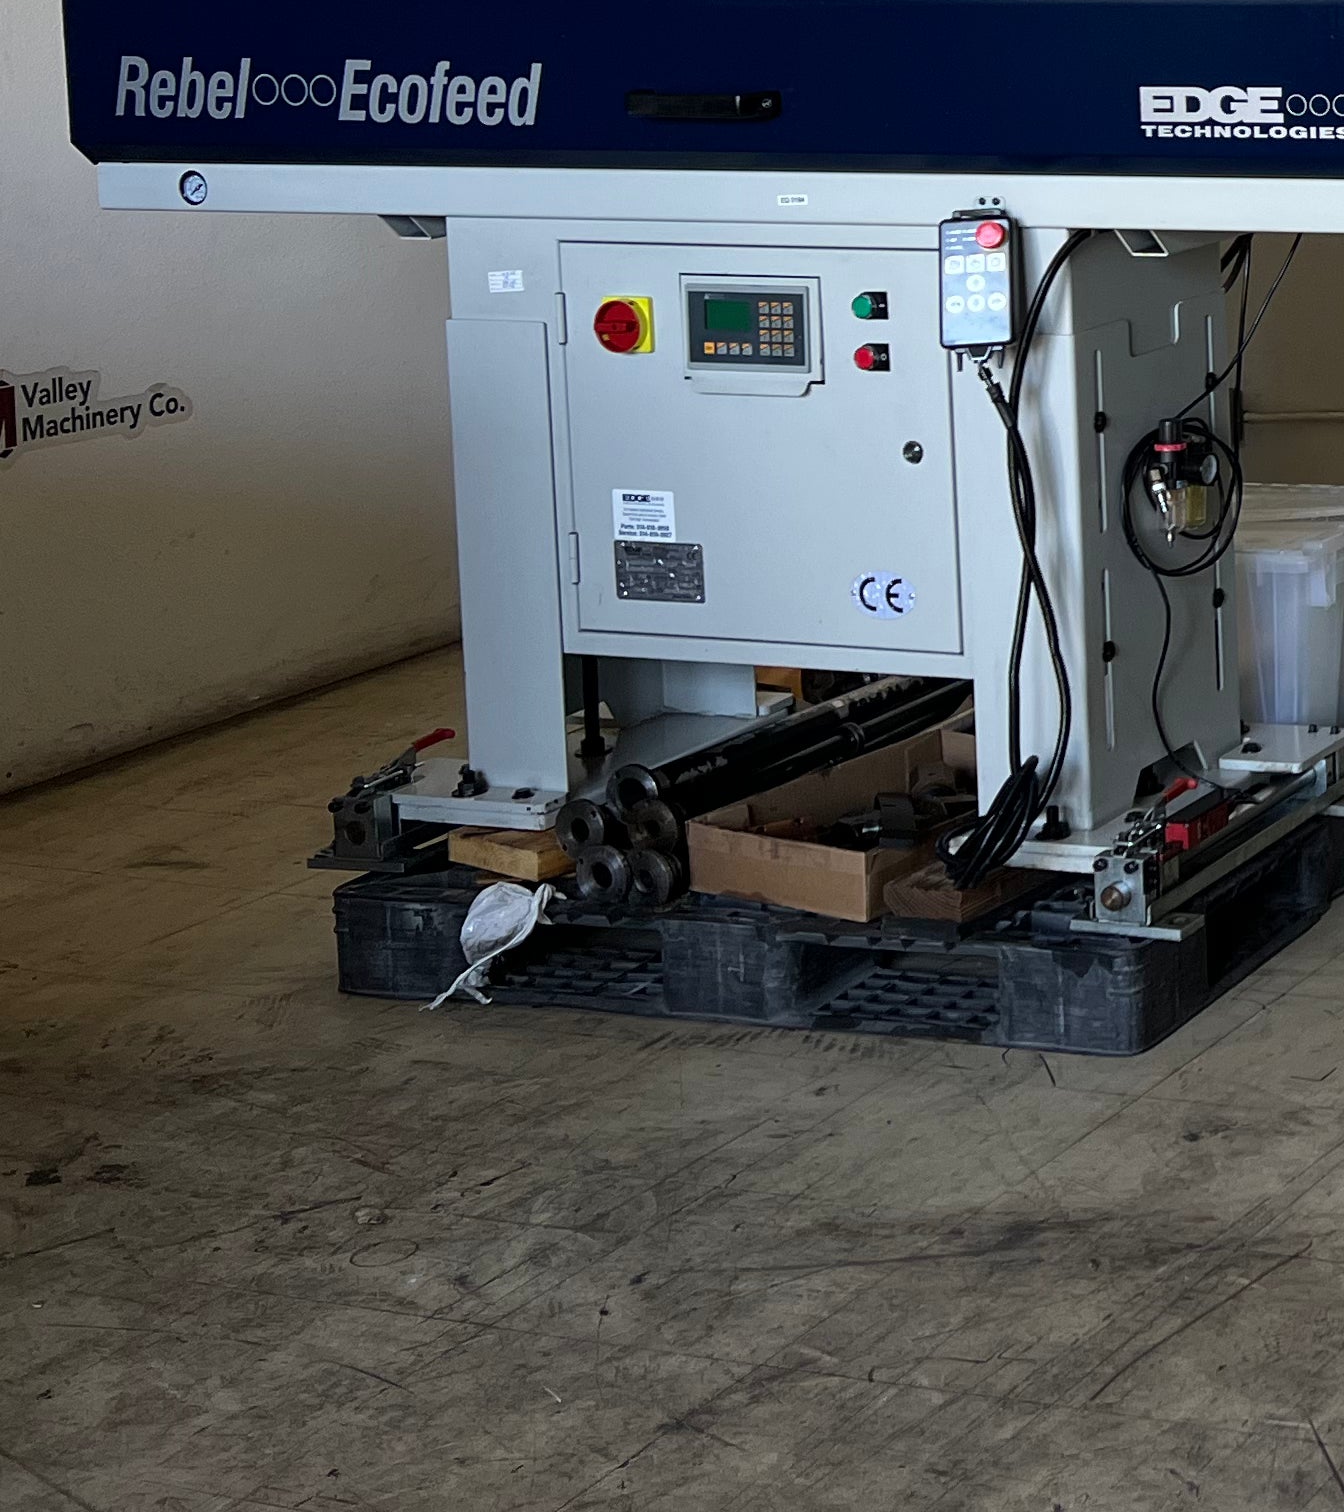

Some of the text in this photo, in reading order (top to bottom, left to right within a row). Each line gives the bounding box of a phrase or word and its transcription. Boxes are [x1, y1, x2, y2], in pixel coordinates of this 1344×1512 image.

[115, 55, 542, 126] Rebel Ecofeed
[1139, 86, 1284, 124] EDGE
[20, 376, 92, 412] Valley
[22, 404, 142, 442] Machinery
[149, 392, 185, 417] Co.
[859, 577, 903, 613] CE
